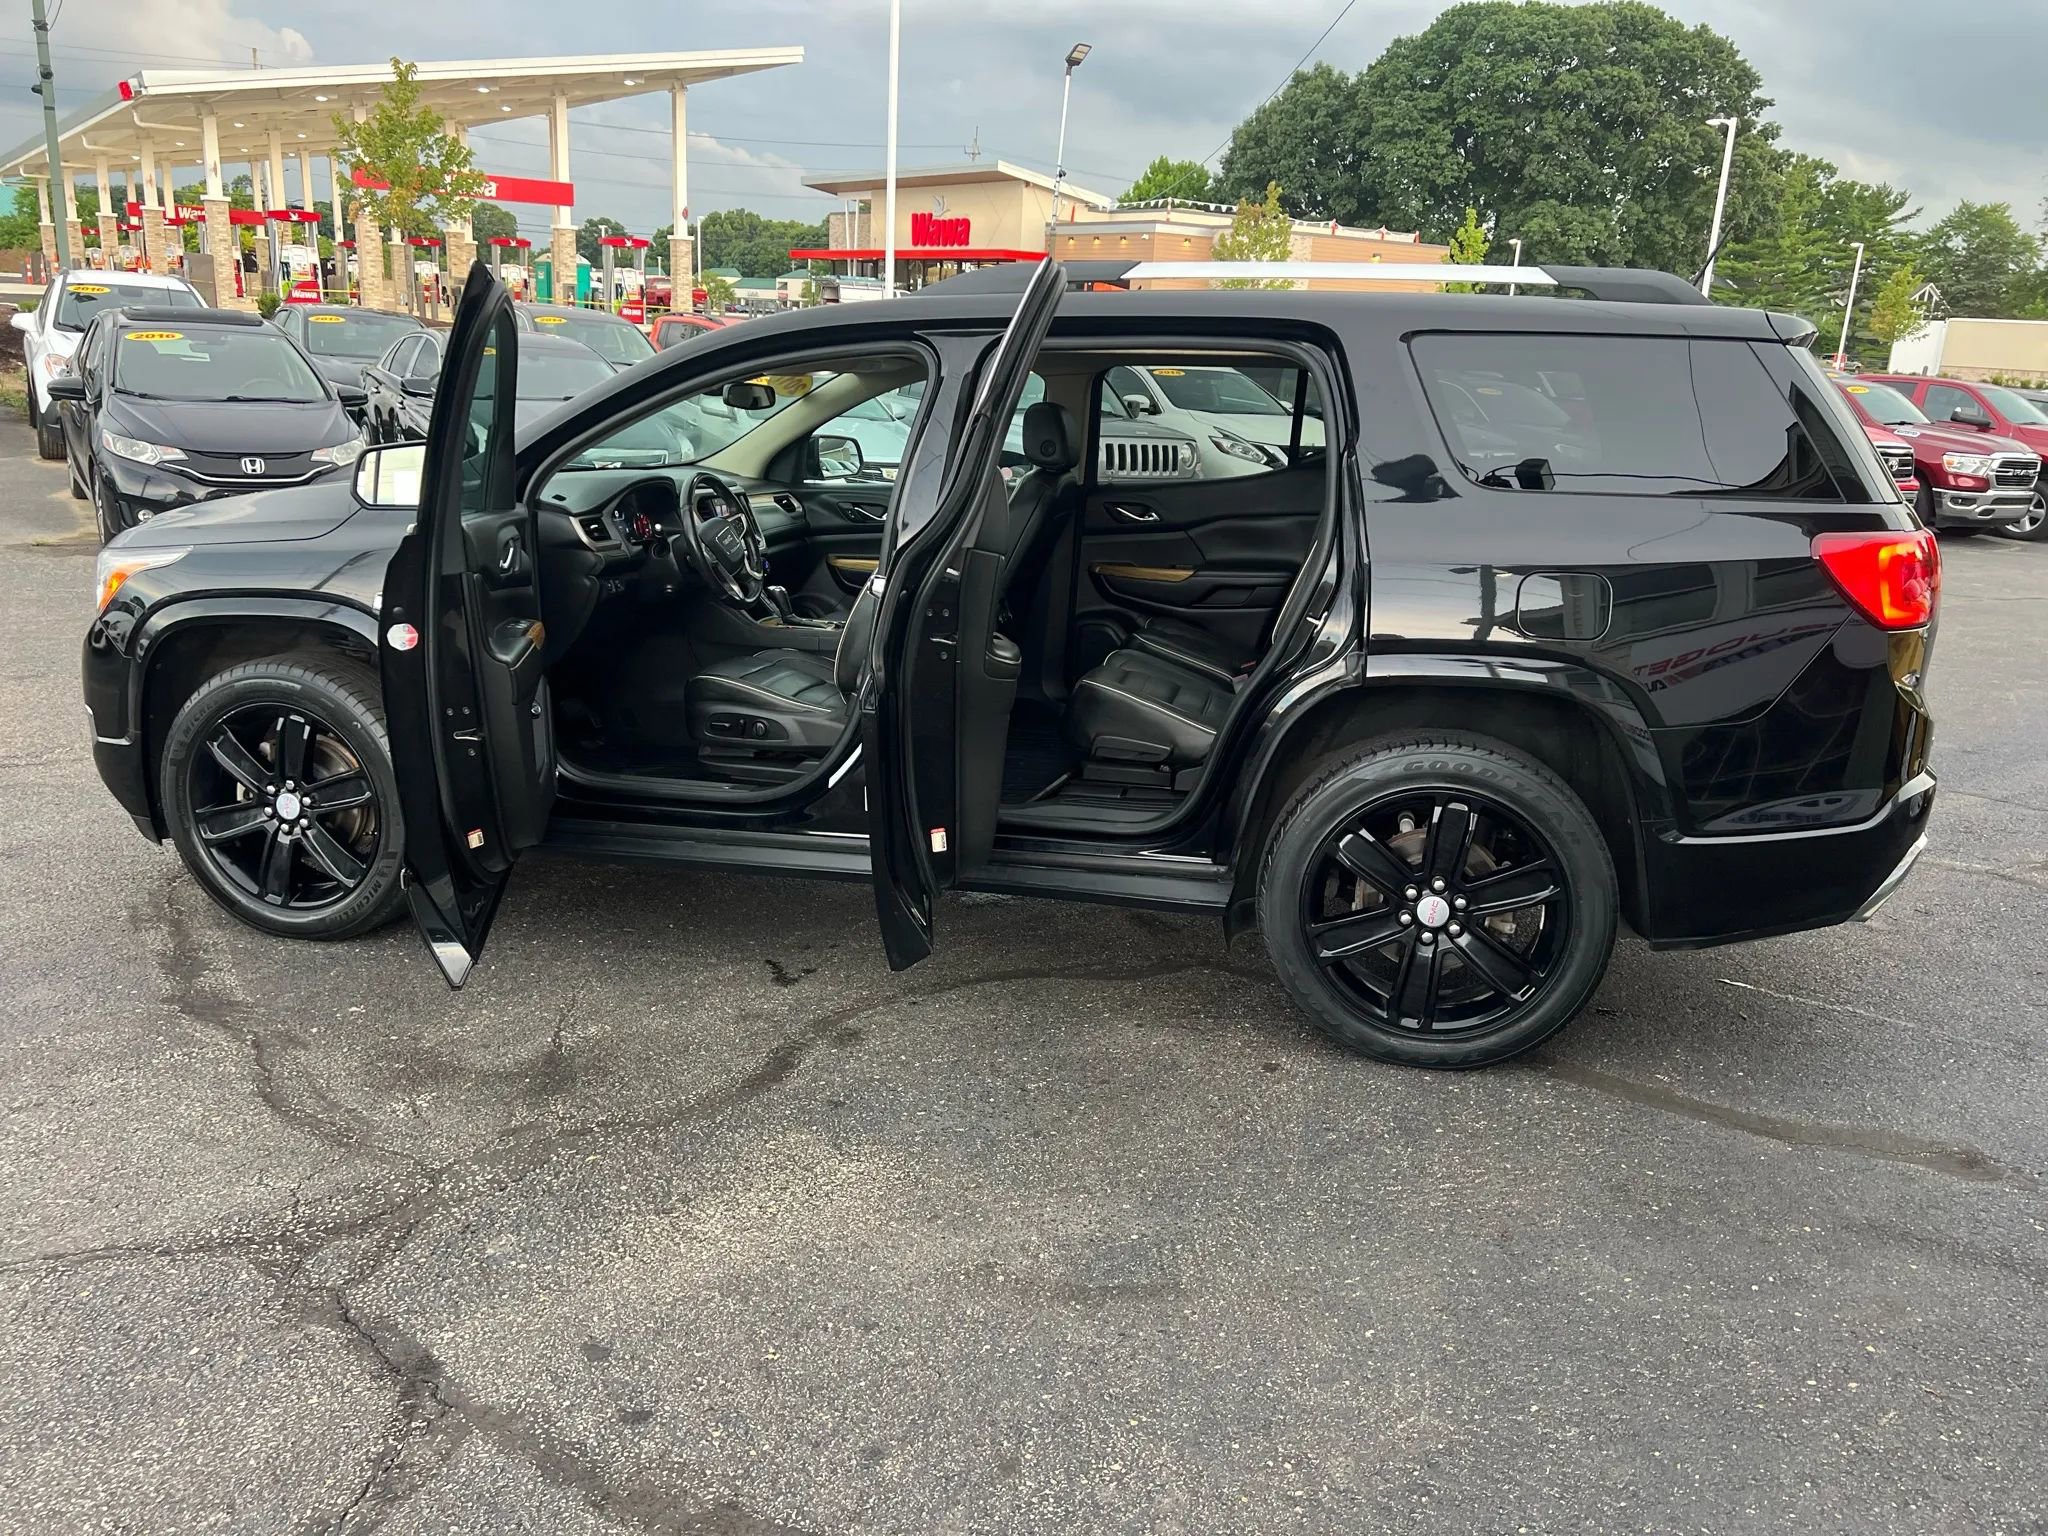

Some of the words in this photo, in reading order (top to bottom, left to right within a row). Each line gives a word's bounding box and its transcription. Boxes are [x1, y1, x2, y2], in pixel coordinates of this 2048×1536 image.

[177, 206, 206, 220] Waw
[911, 212, 970, 247] Wawa
[291, 290, 318, 299] Wawa
[1427, 900, 1440, 924] GMC
